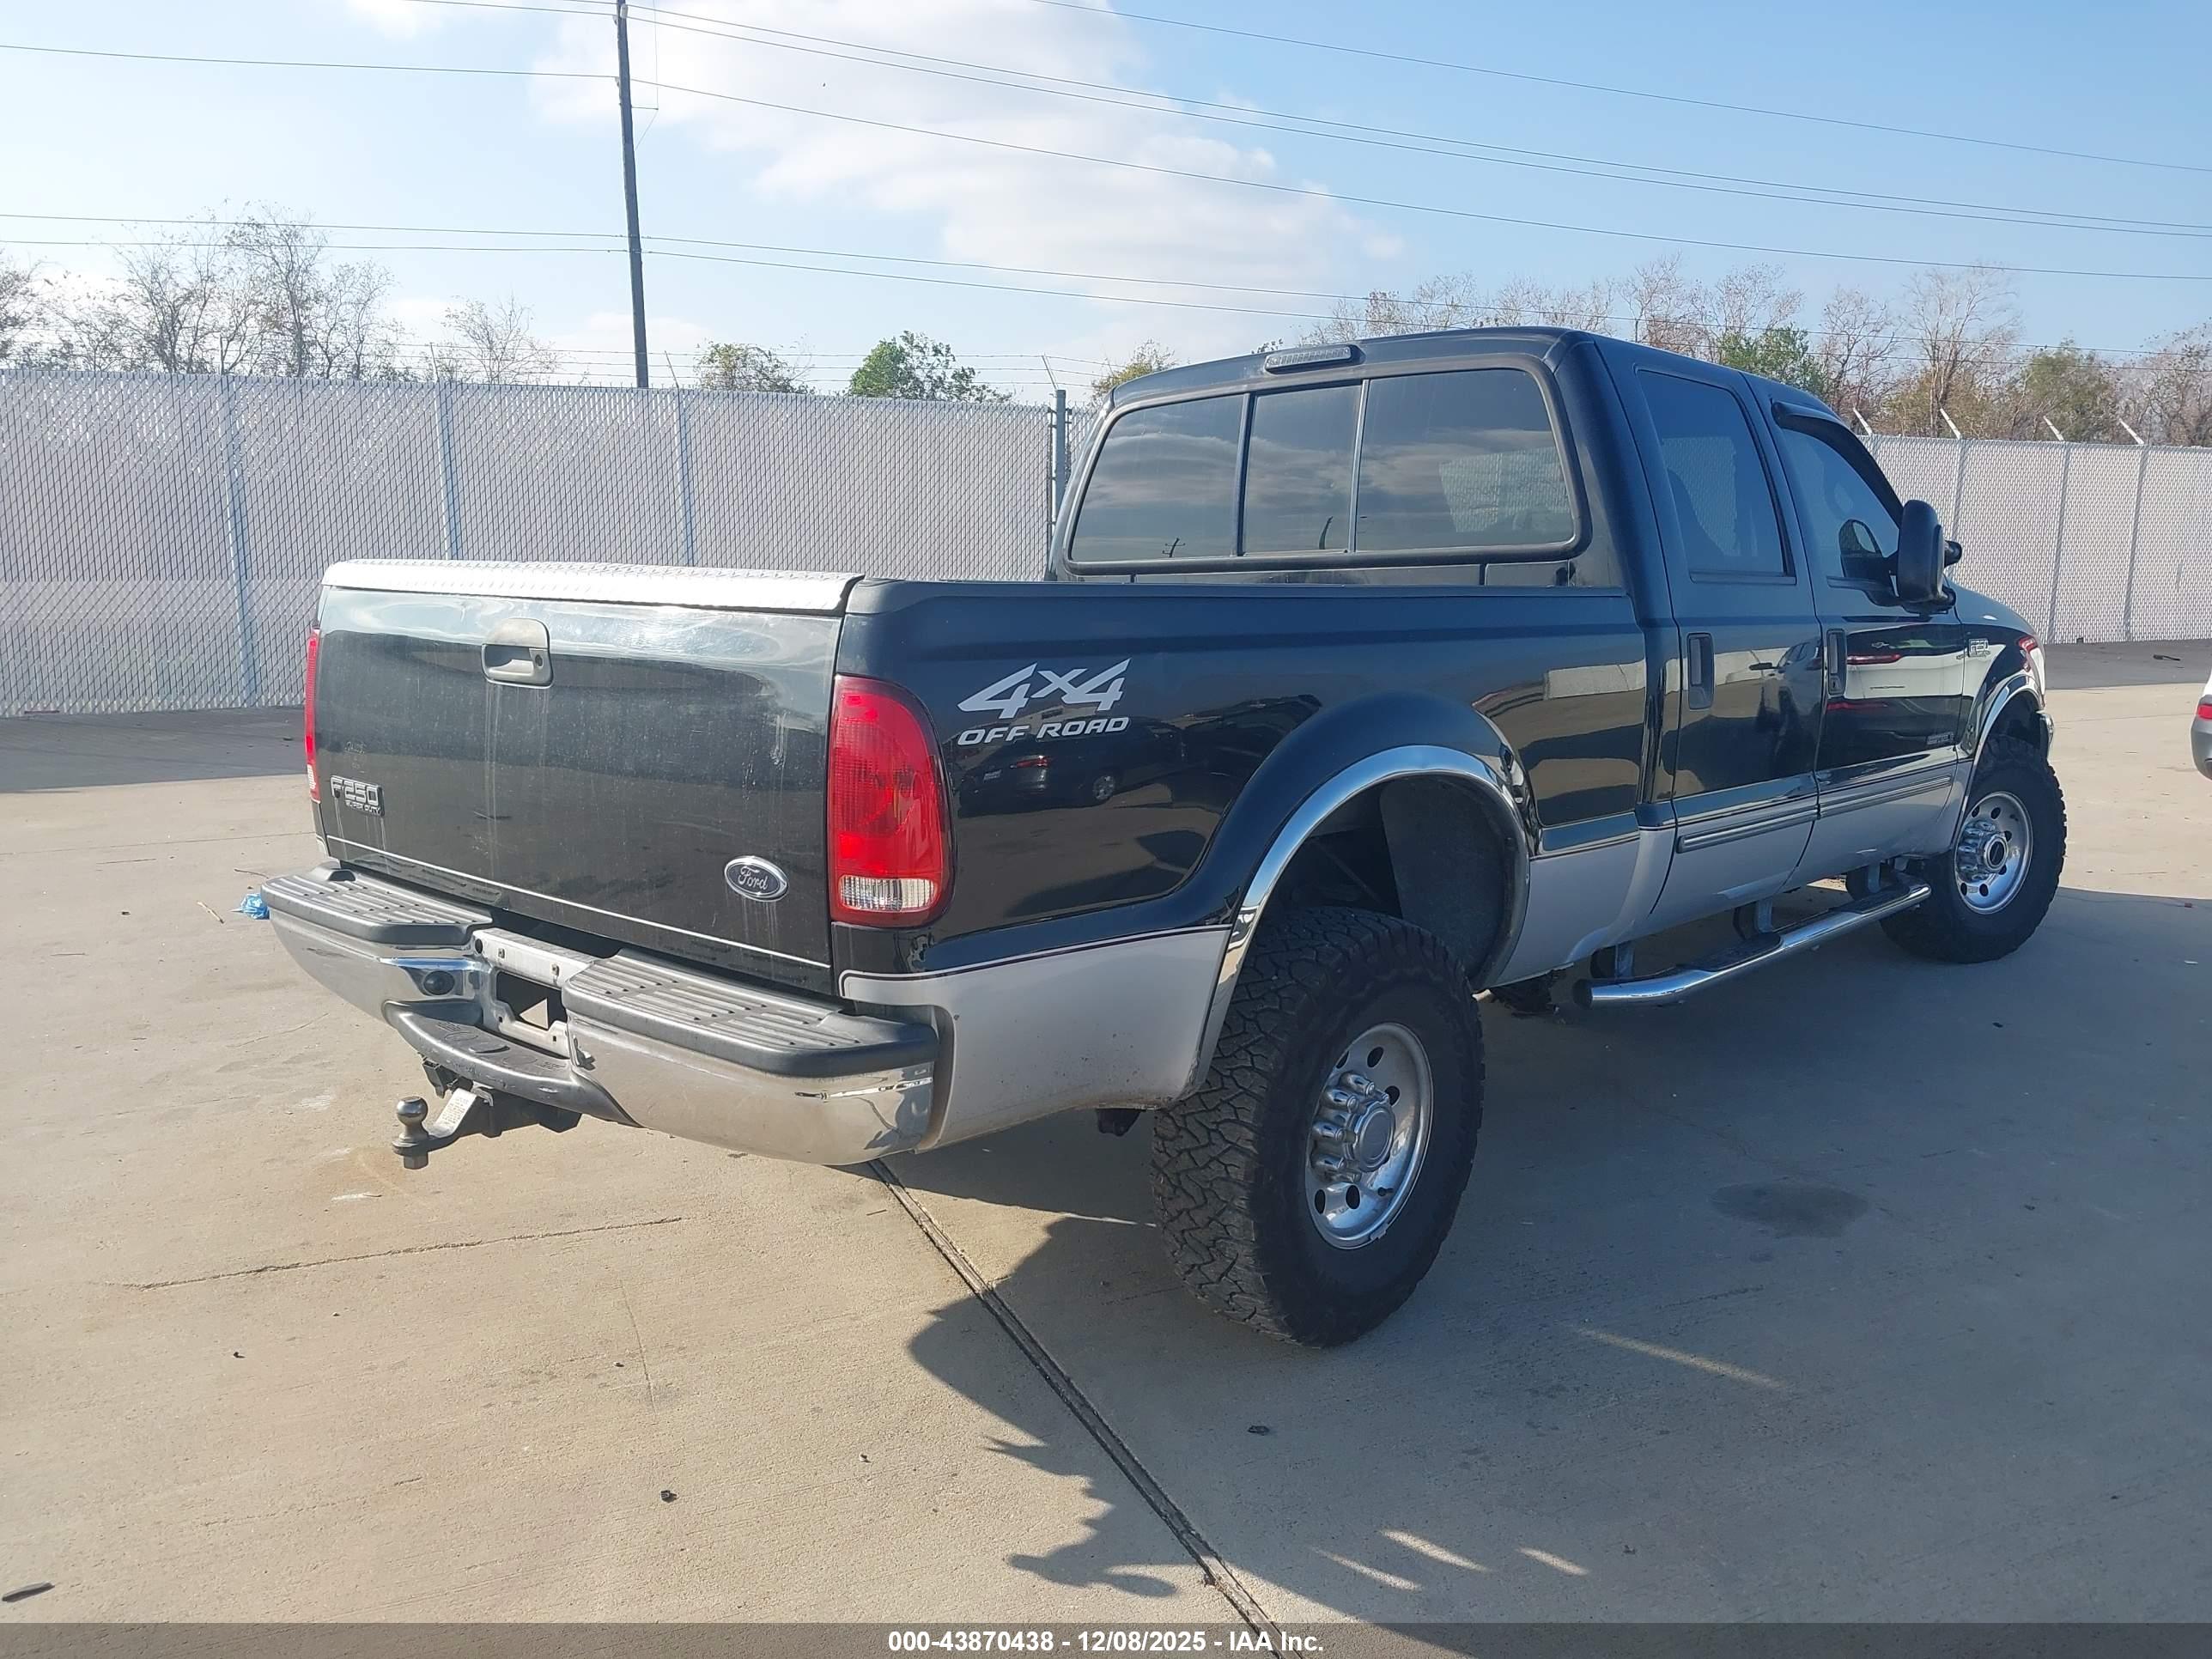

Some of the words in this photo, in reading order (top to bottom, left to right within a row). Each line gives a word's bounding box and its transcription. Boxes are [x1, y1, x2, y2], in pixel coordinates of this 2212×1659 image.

[957, 725, 1030, 745] OFF
[1036, 717, 1130, 738] ROAD
[738, 866, 769, 890] Ford
